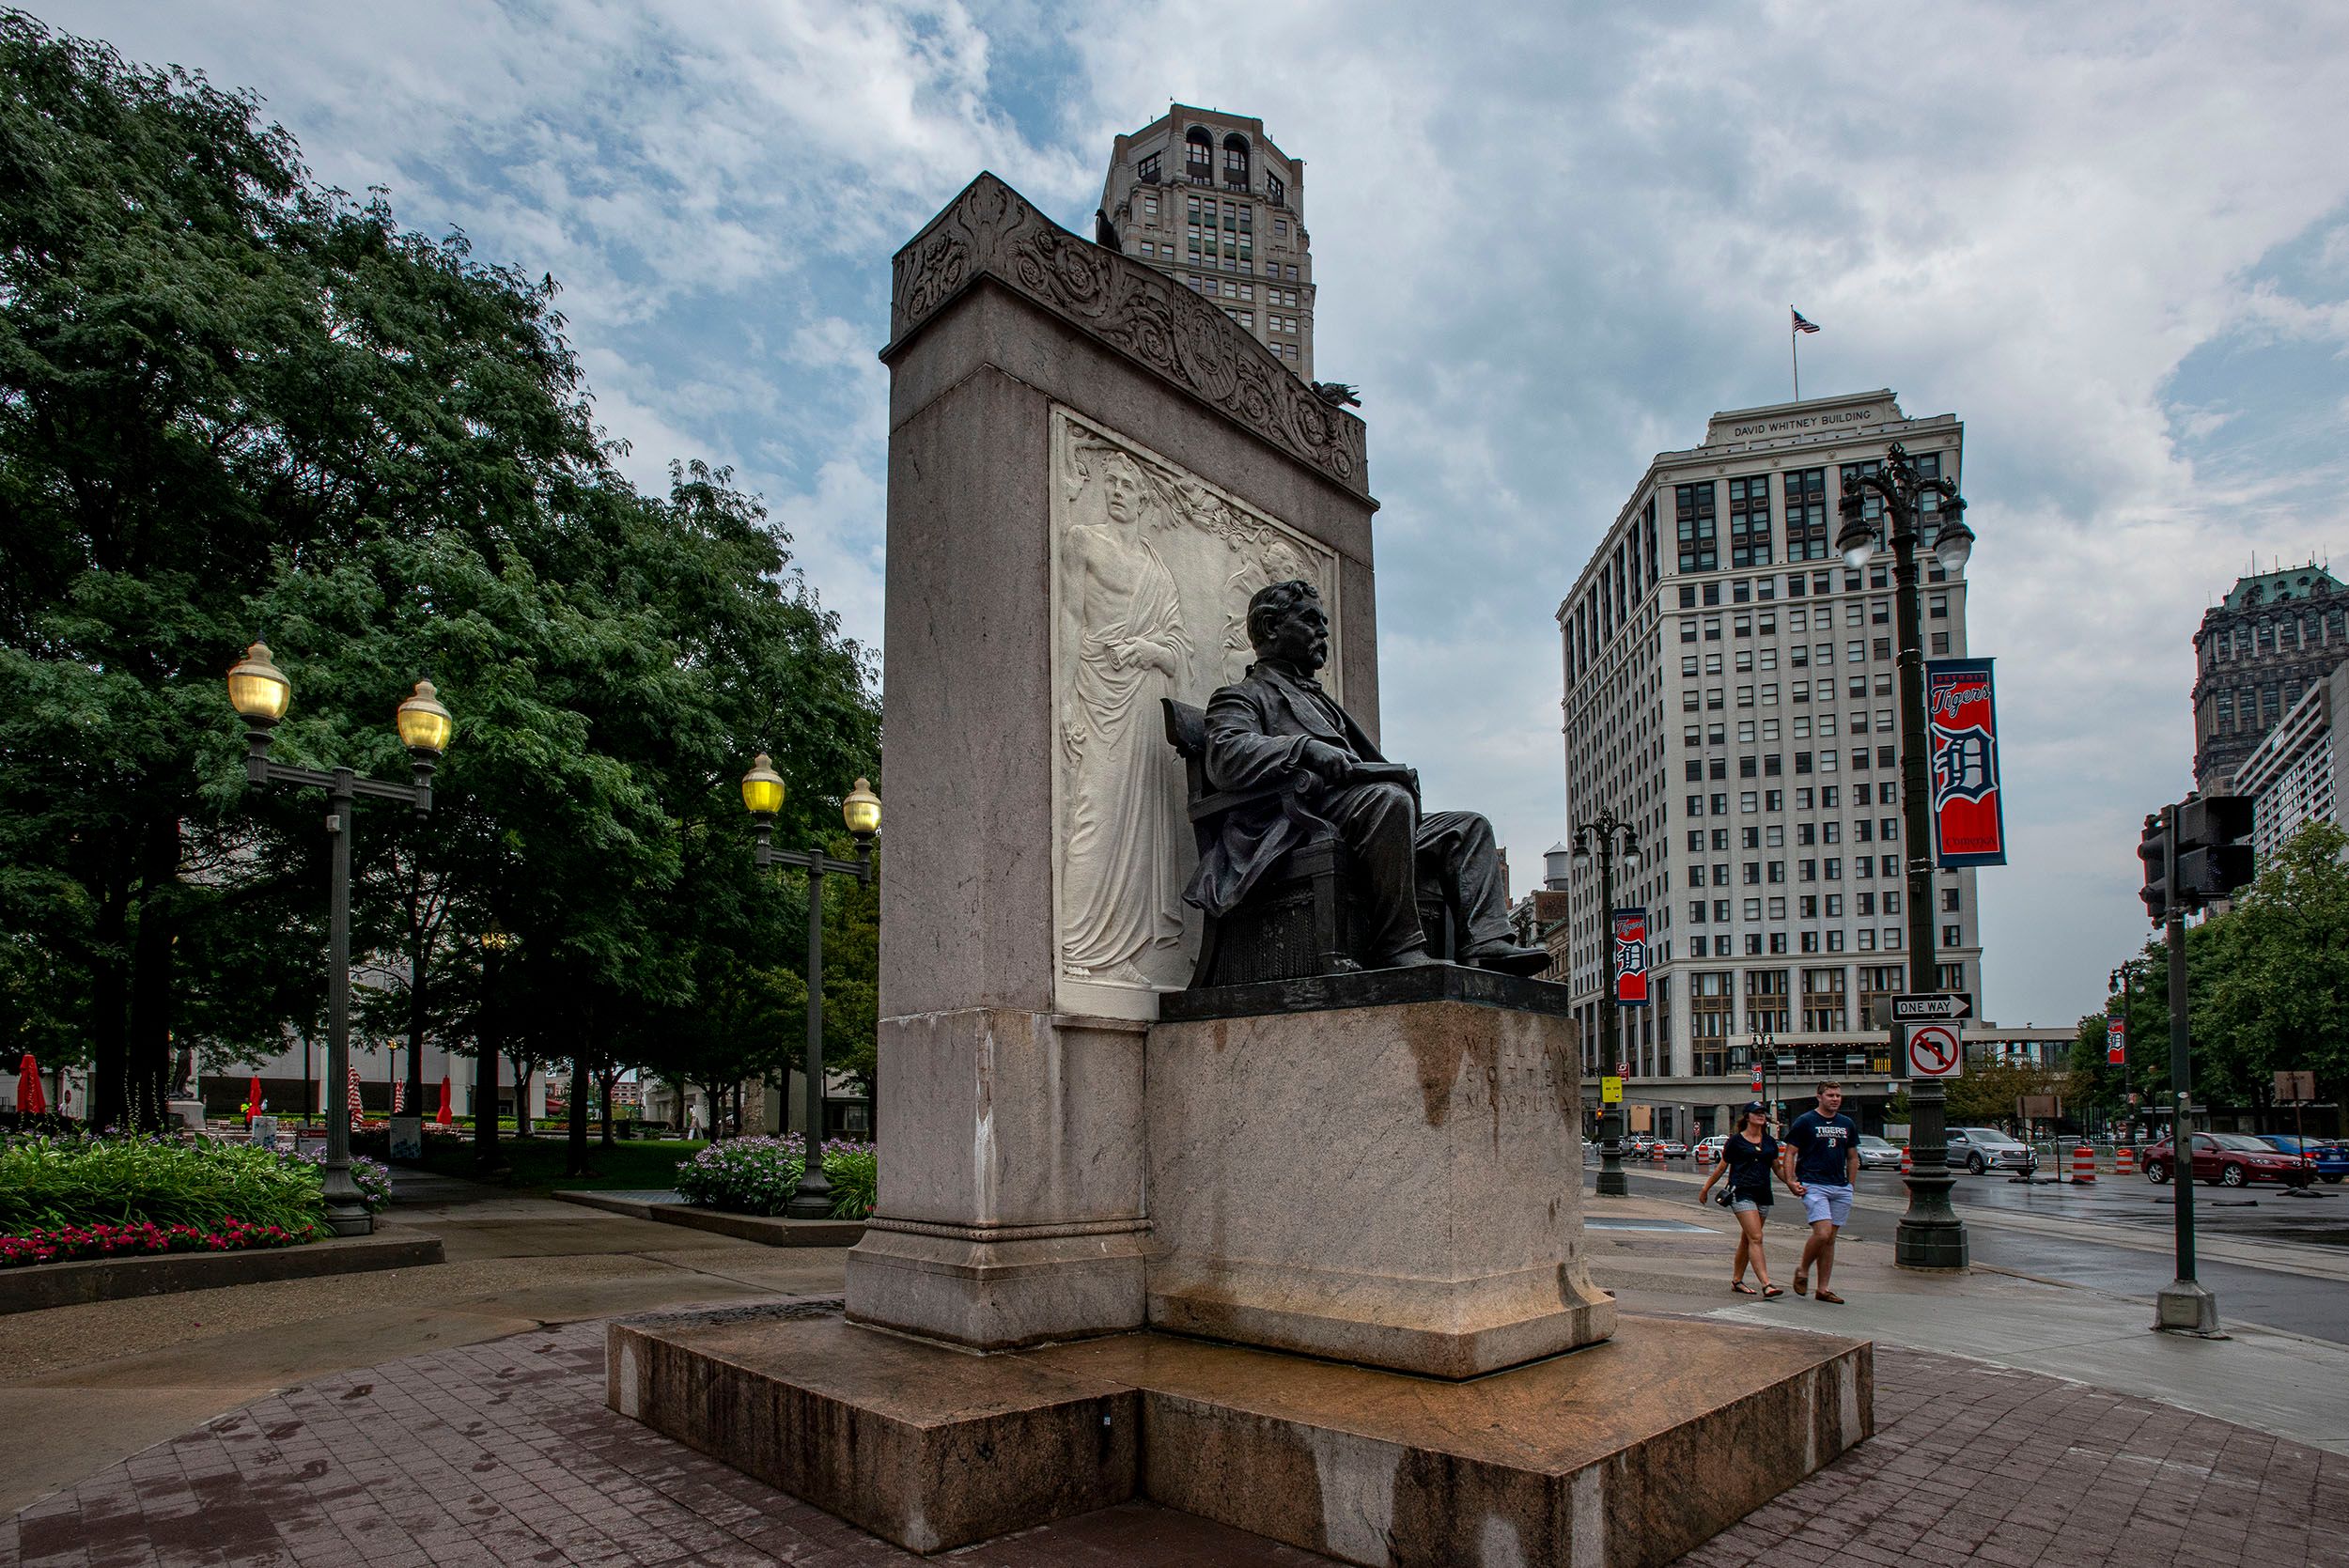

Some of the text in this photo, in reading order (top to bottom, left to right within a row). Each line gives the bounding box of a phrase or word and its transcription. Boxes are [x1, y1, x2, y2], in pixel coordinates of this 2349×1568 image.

[1735, 410, 1872, 437] DAVID WHITNEY BUILDING
[1937, 674, 1985, 682] DETROIT
[1930, 681, 1992, 719] Tigers
[1929, 722, 1999, 814] D
[1616, 918, 1646, 937] Tigers
[1615, 938, 1648, 981] D
[1900, 1001, 1951, 1013] ONE WAY
[1466, 1063, 1569, 1089] COTTER
[1465, 1092, 1571, 1119] MAYBURY
[1814, 1126, 1847, 1135] TIGERS
